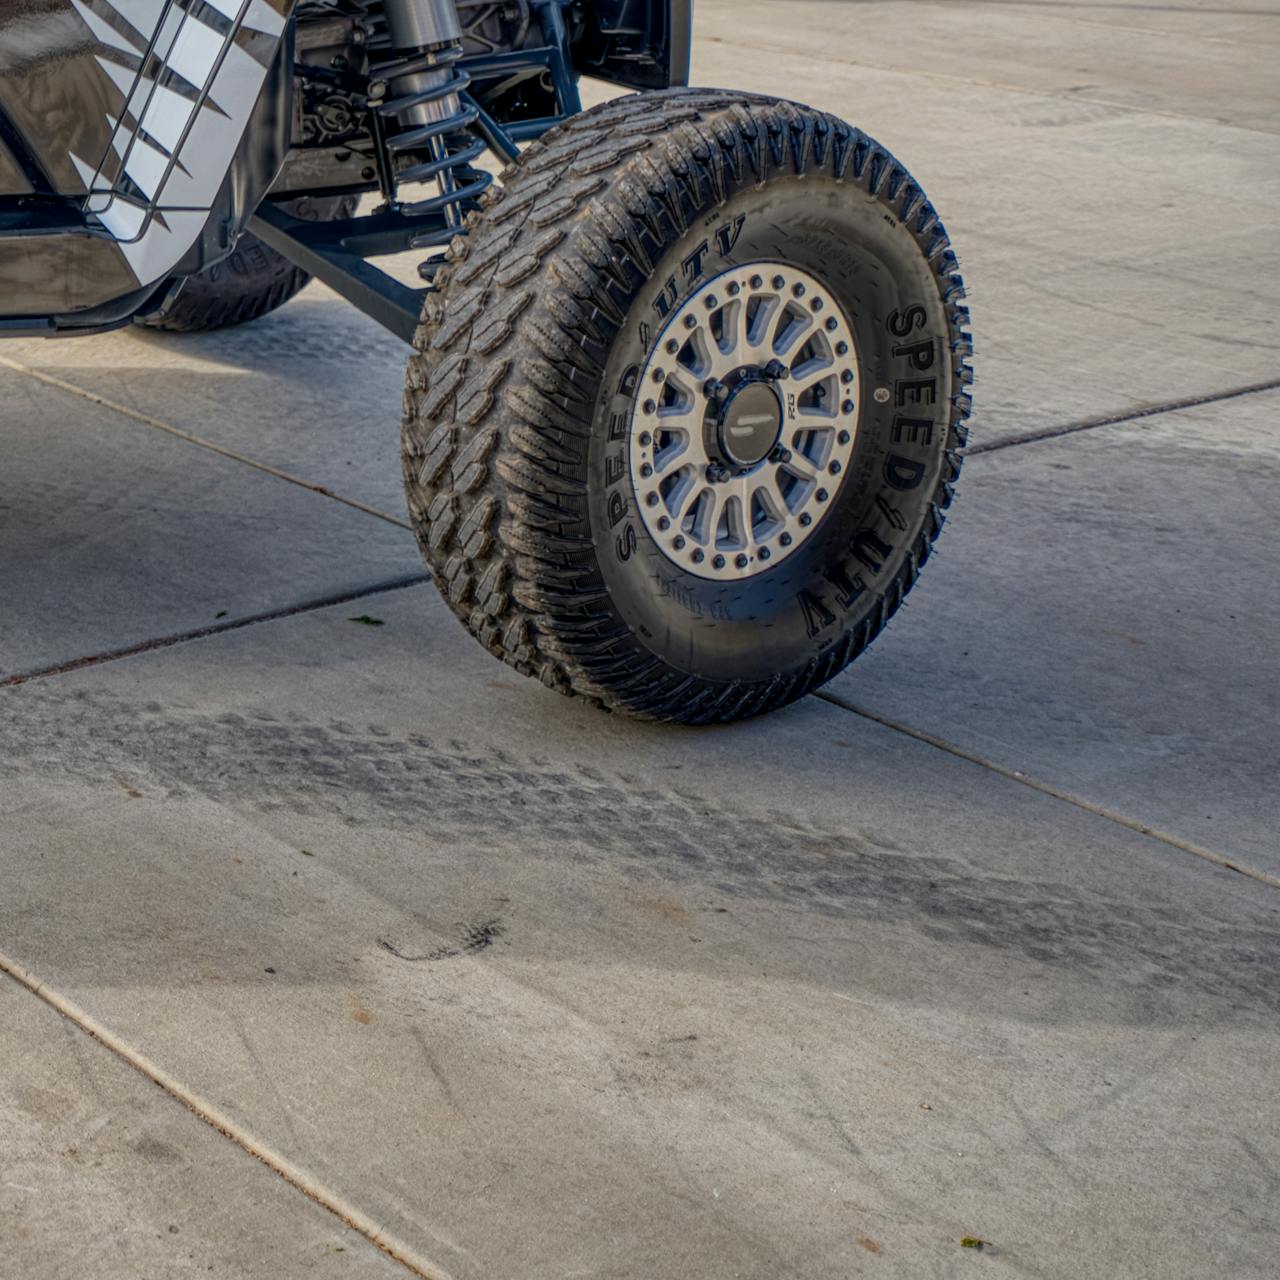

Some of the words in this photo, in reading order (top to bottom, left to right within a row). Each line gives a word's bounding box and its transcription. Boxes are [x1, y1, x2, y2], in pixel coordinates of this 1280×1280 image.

[605, 365, 641, 563] SPEED
[652, 216, 746, 320] UTV
[883, 304, 937, 492] SPEED
[796, 528, 894, 638] UTV
